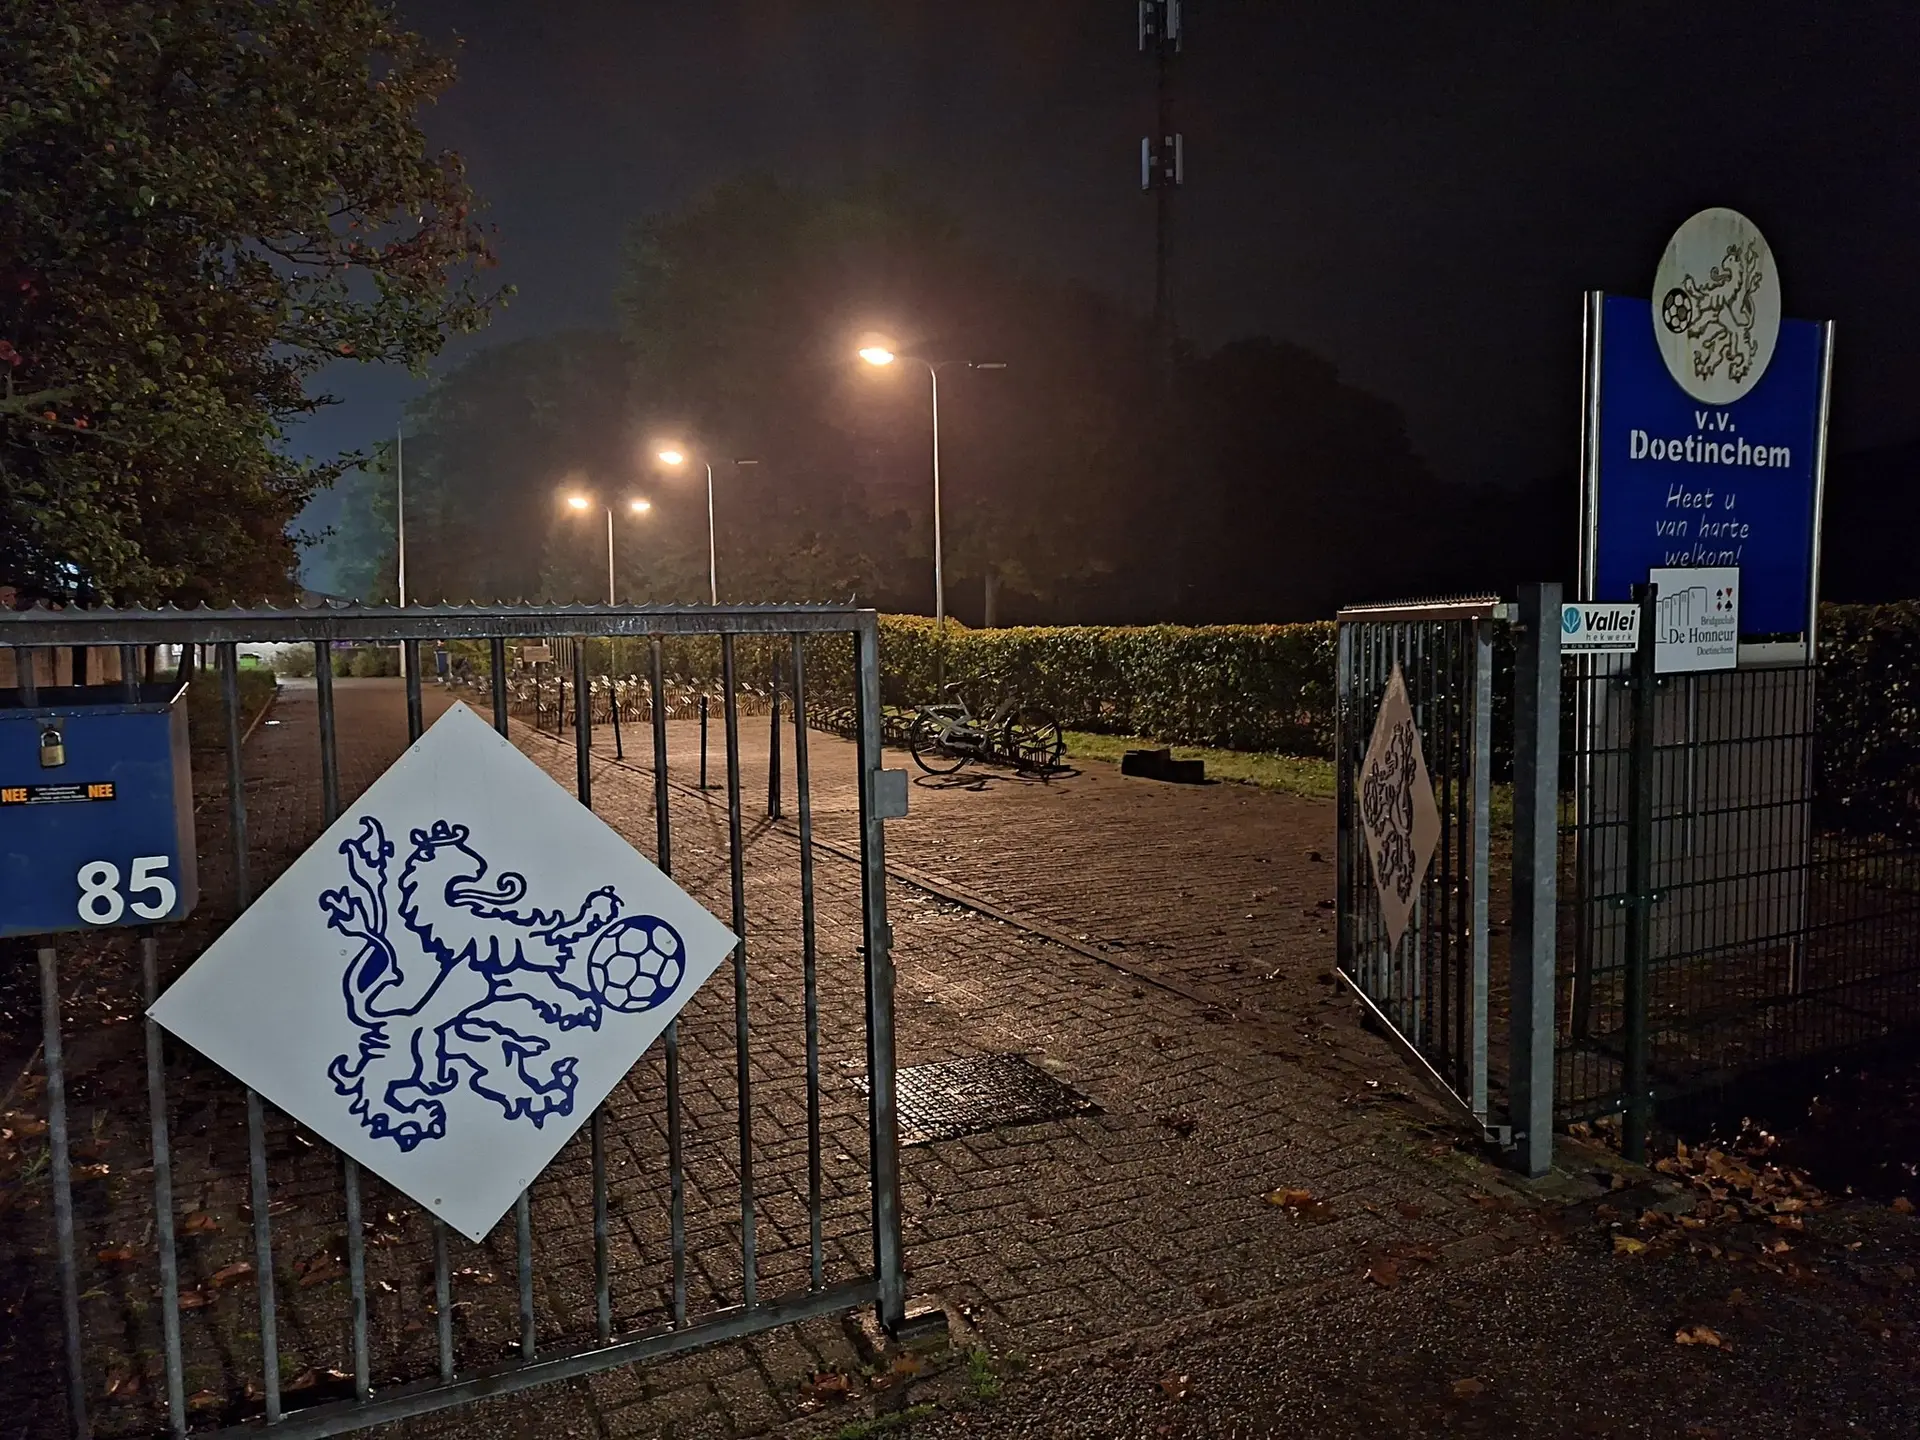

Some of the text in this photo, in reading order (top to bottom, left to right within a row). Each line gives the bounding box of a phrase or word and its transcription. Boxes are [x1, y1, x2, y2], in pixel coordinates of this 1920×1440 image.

[1630, 429, 1791, 468] Doetinchem
[1665, 483, 1735, 510] Heet u
[1655, 514, 1749, 539] van harte
[1664, 543, 1742, 567] welkom!
[1585, 610, 1636, 632] Vallei
[1669, 627, 1735, 645] De Honneur
[2, 789, 27, 802] NEE
[88, 784, 113, 798] NEE
[77, 855, 177, 926] 85
